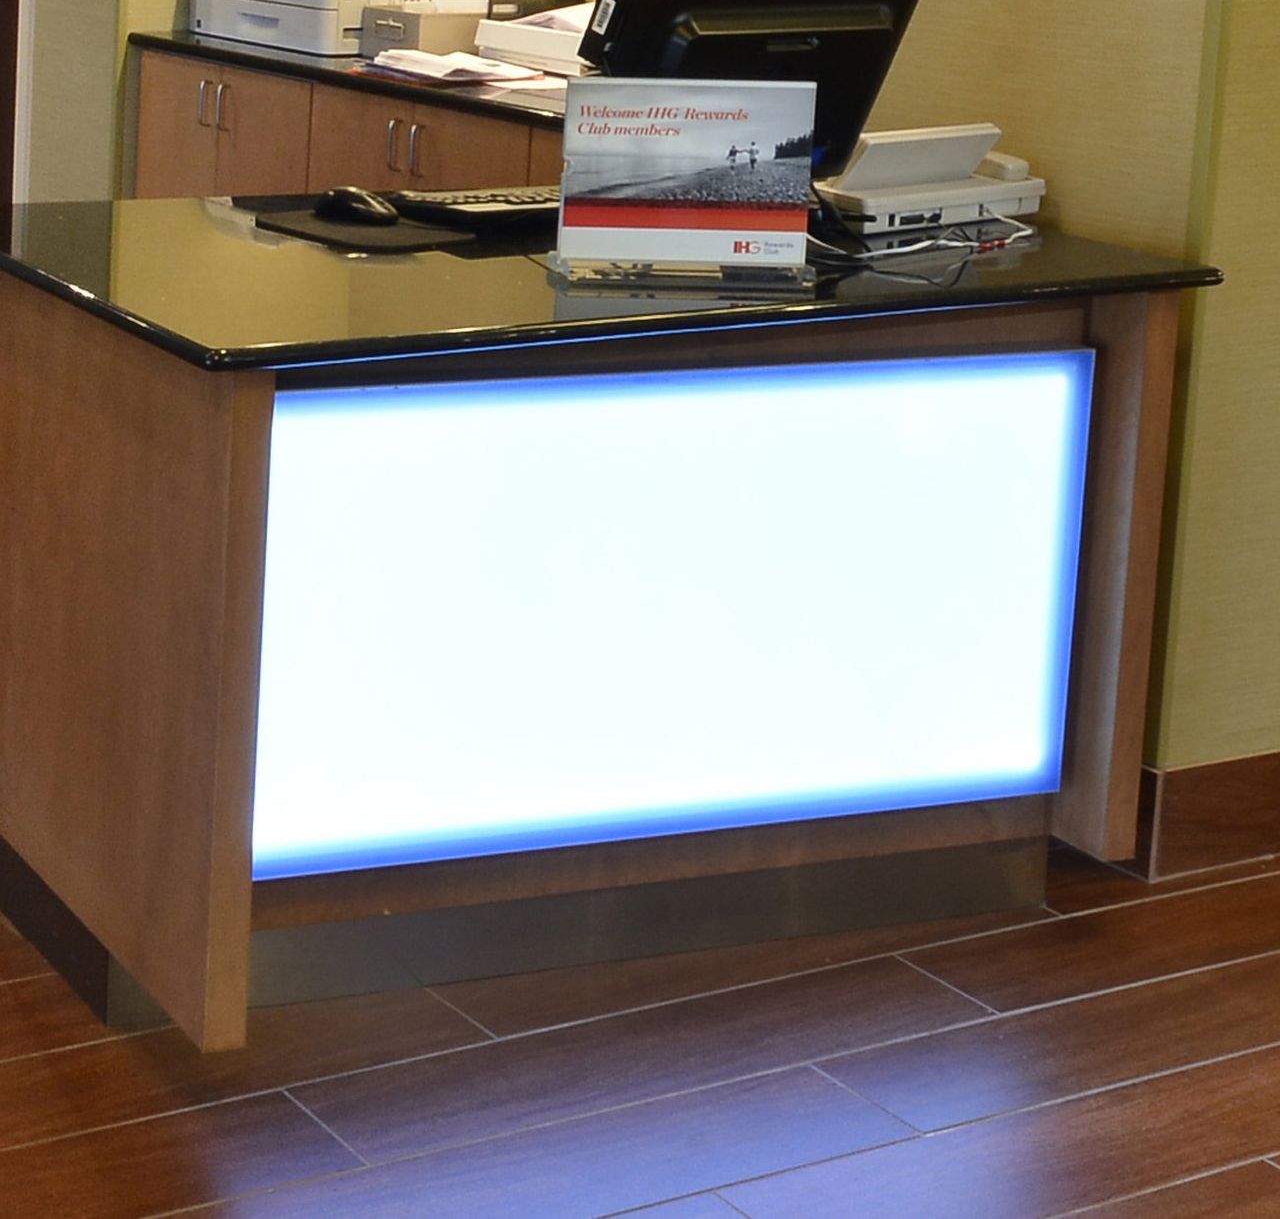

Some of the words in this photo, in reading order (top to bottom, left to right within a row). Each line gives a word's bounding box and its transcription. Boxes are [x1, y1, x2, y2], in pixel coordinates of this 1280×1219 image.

[579, 105, 643, 119] Welcome
[646, 107, 680, 120] IHG
[684, 108, 749, 121] Rewards
[577, 122, 611, 135] Club
[614, 124, 681, 137] members
[734, 241, 761, 254] IHG
